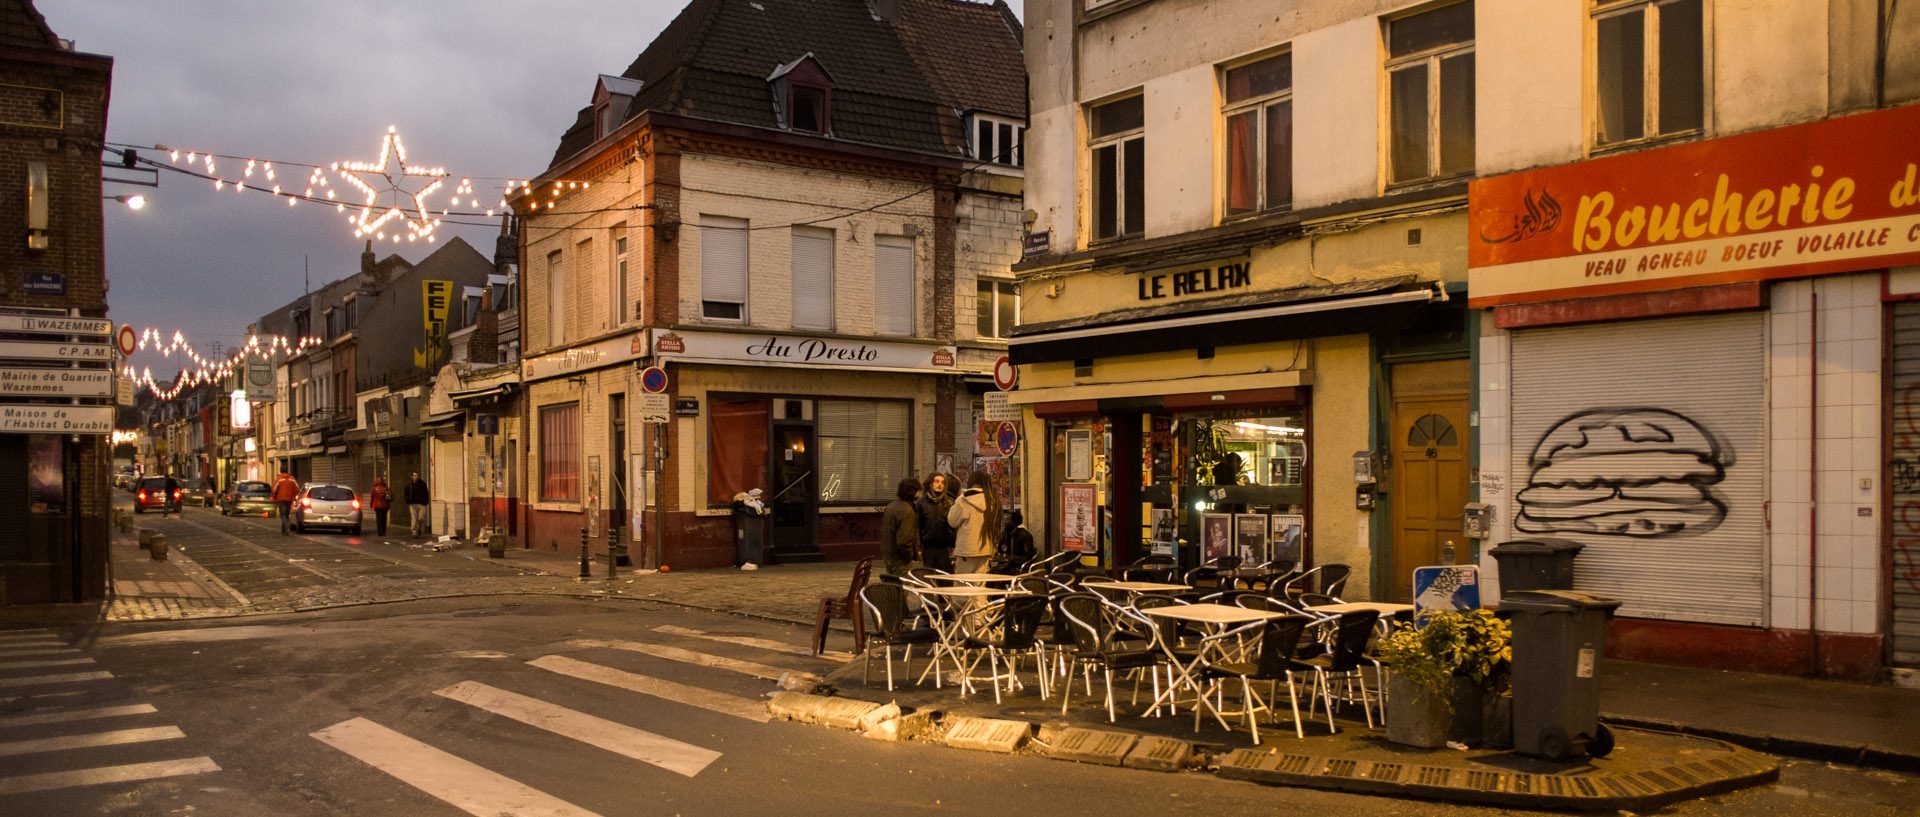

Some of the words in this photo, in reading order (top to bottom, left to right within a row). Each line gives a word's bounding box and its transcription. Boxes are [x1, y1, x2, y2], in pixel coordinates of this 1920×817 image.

[1572, 165, 1856, 253] Boucherie
[1889, 163, 1920, 208] d
[1585, 258, 1627, 278] VEAU
[1637, 248, 1708, 271] AGNEAU
[1721, 239, 1784, 262] BOEUF
[1797, 227, 1891, 254] VOLAILLE
[1138, 275, 1167, 300] LE
[1173, 262, 1251, 296] RELAX
[428, 282, 445, 349] FELIX
[38, 320, 107, 331] WAZEMMES
[58, 346, 108, 357] C.P.A.M.
[746, 336, 793, 358] Au
[798, 338, 880, 362] Presto
[1, 371, 38, 380] Mairie
[42, 373, 56, 381] de
[61, 373, 107, 382] Quartier
[2, 382, 64, 392] Wazemmes
[5, 409, 47, 418] Maison
[53, 410, 67, 418] de
[4, 419, 57, 429] l'Habitat
[63, 420, 109, 430] Durable
[1425, 448, 1438, 459] 46
